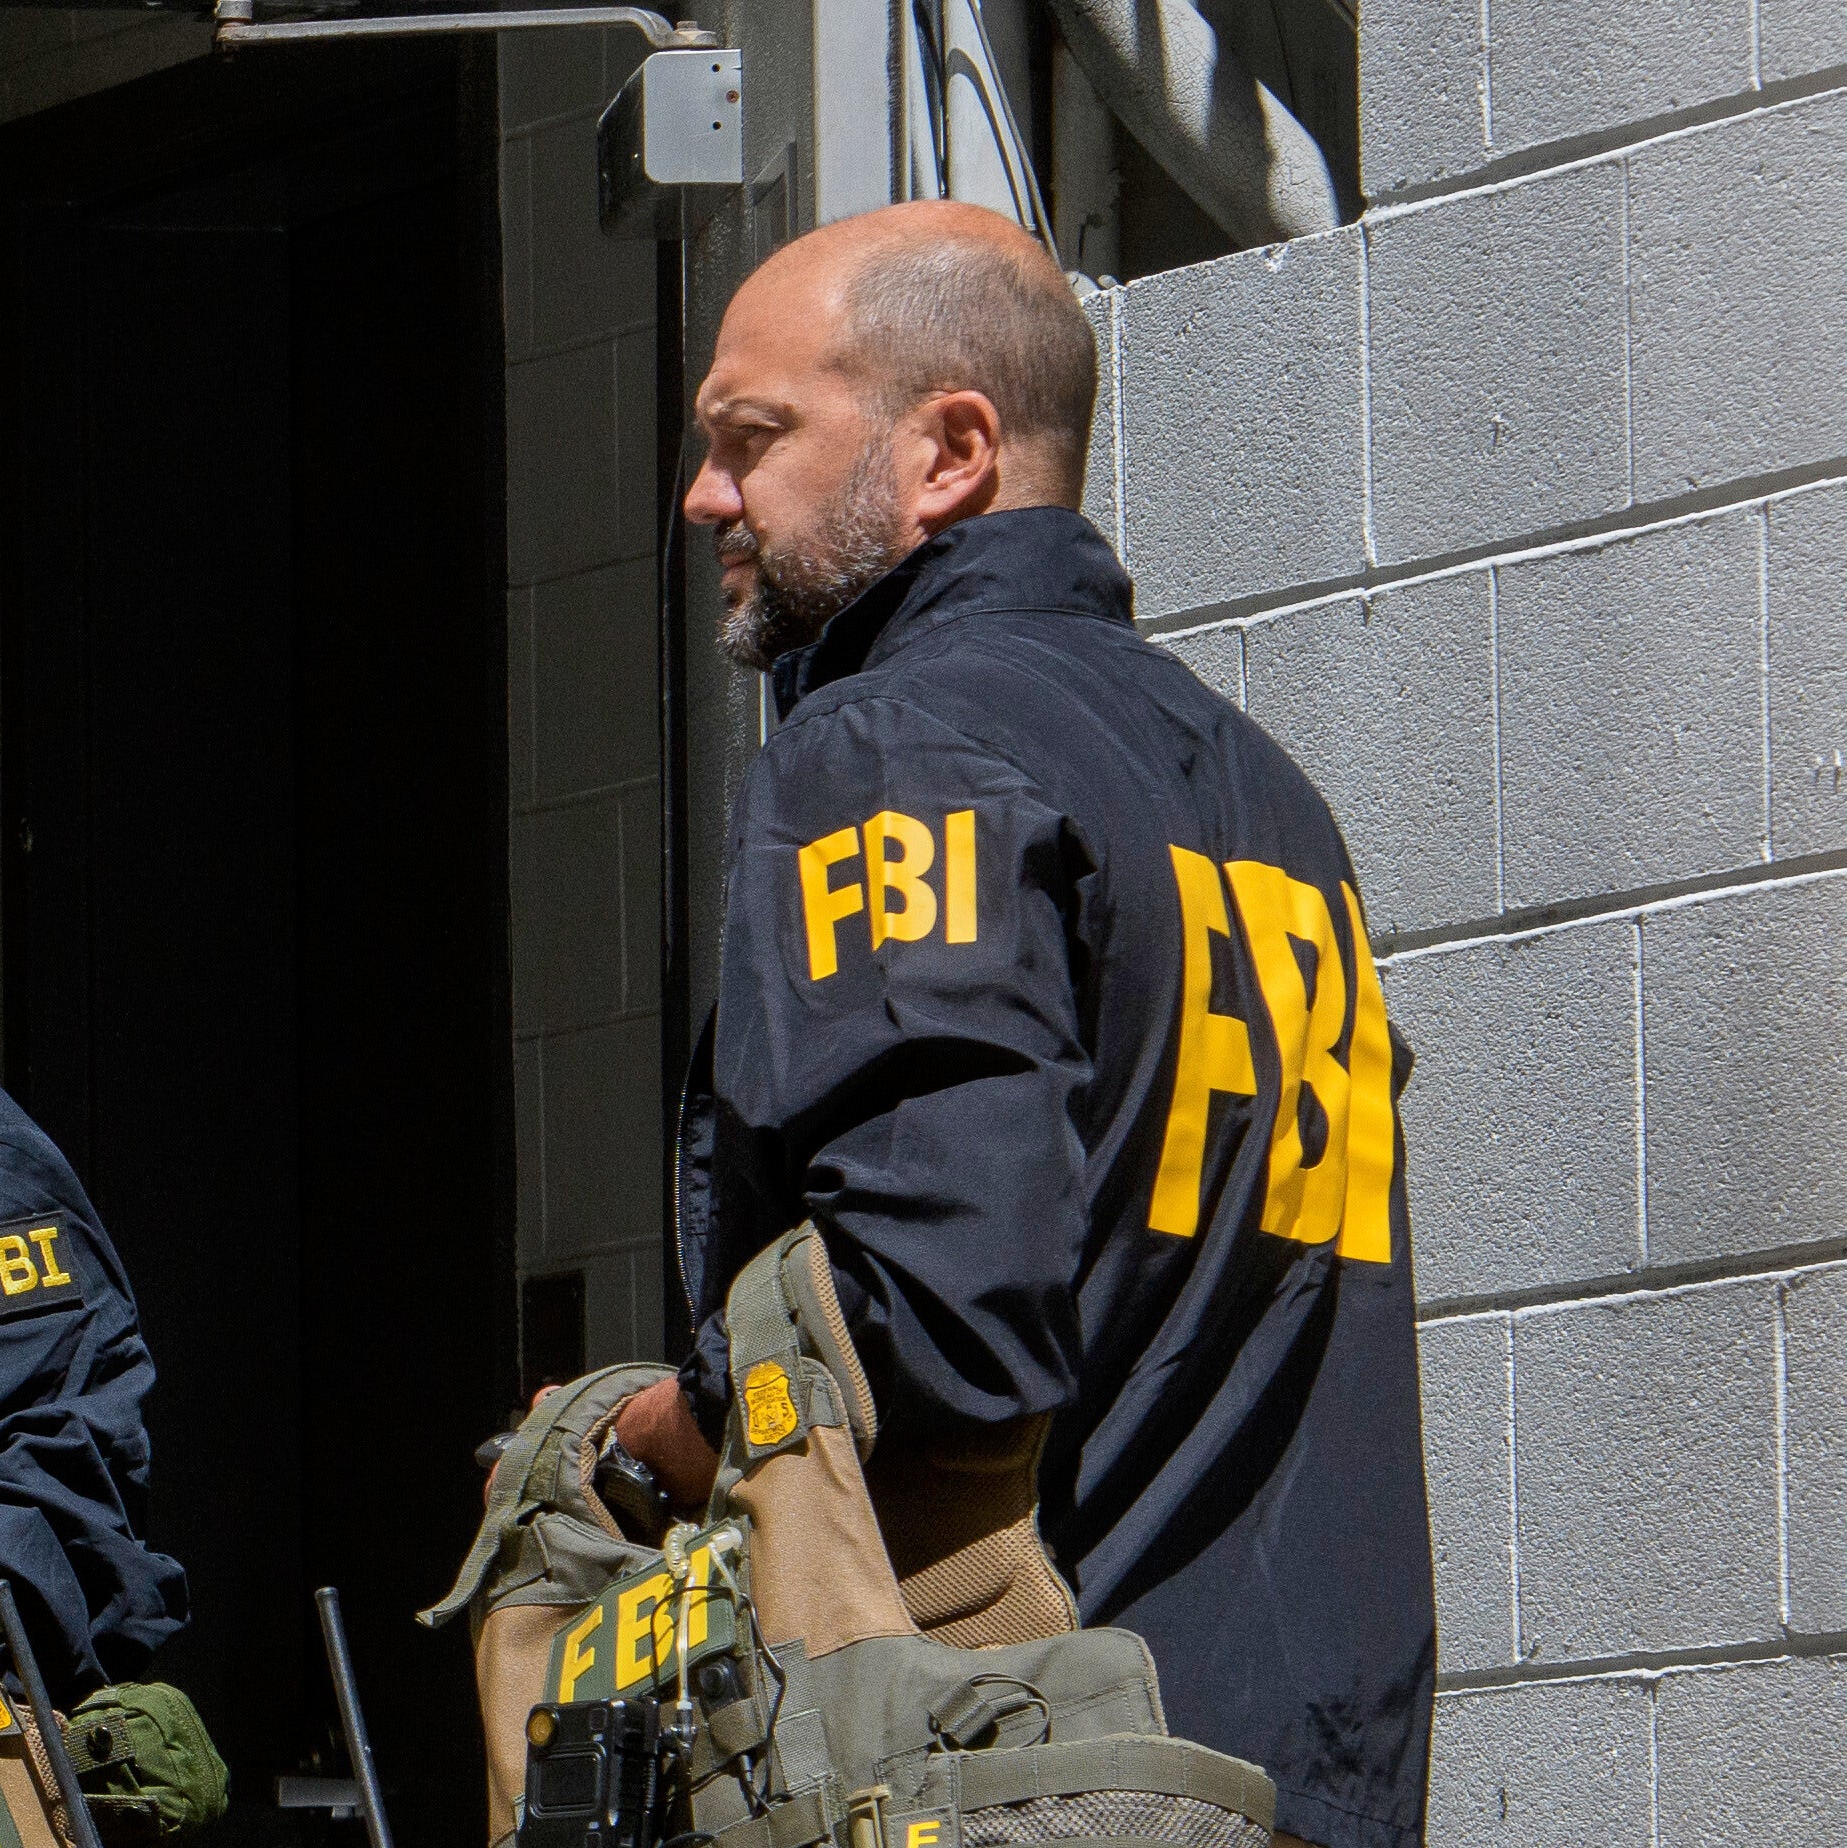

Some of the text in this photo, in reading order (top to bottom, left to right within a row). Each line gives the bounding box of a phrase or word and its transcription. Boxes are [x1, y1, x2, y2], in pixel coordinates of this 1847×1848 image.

[799, 810, 977, 981] FBI
[1148, 843, 1392, 1264] FBI
[558, 1546, 710, 1704] FBI
